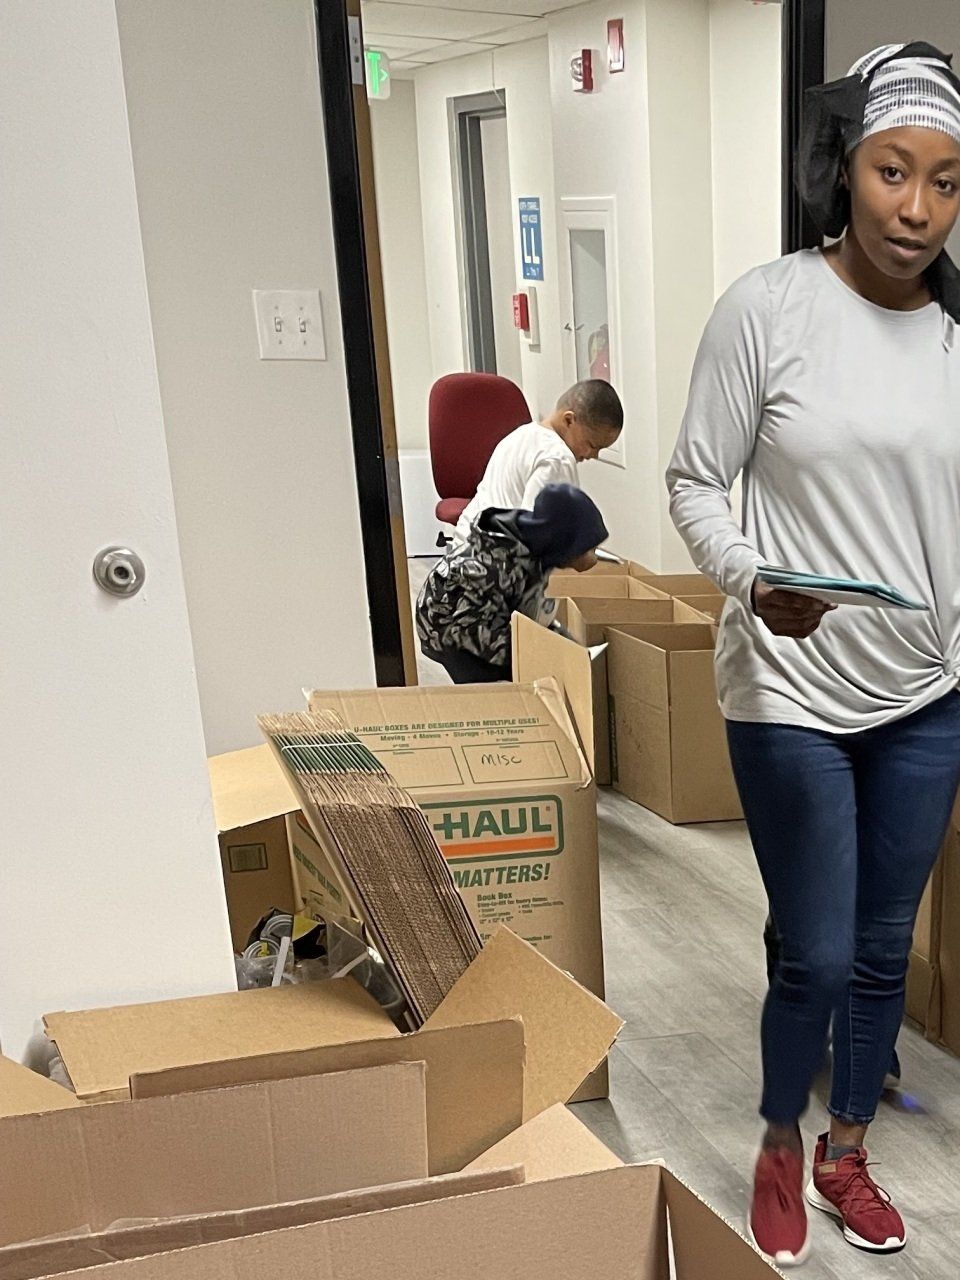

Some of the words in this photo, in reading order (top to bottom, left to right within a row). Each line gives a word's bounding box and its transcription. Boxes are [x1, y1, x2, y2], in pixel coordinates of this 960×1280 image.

[384, 723, 409, 732] BOXES
[411, 722, 426, 731] ARE
[427, 721, 465, 730] DESIGNED
[466, 720, 481, 728] FOR
[482, 718, 517, 727] MULTIPLE
[380, 734, 406, 742] Moving
[426, 806, 552, 840] -HAUL
[453, 863, 551, 889] MATTERS!
[477, 893, 496, 902] Book
[498, 892, 512, 900] Box
